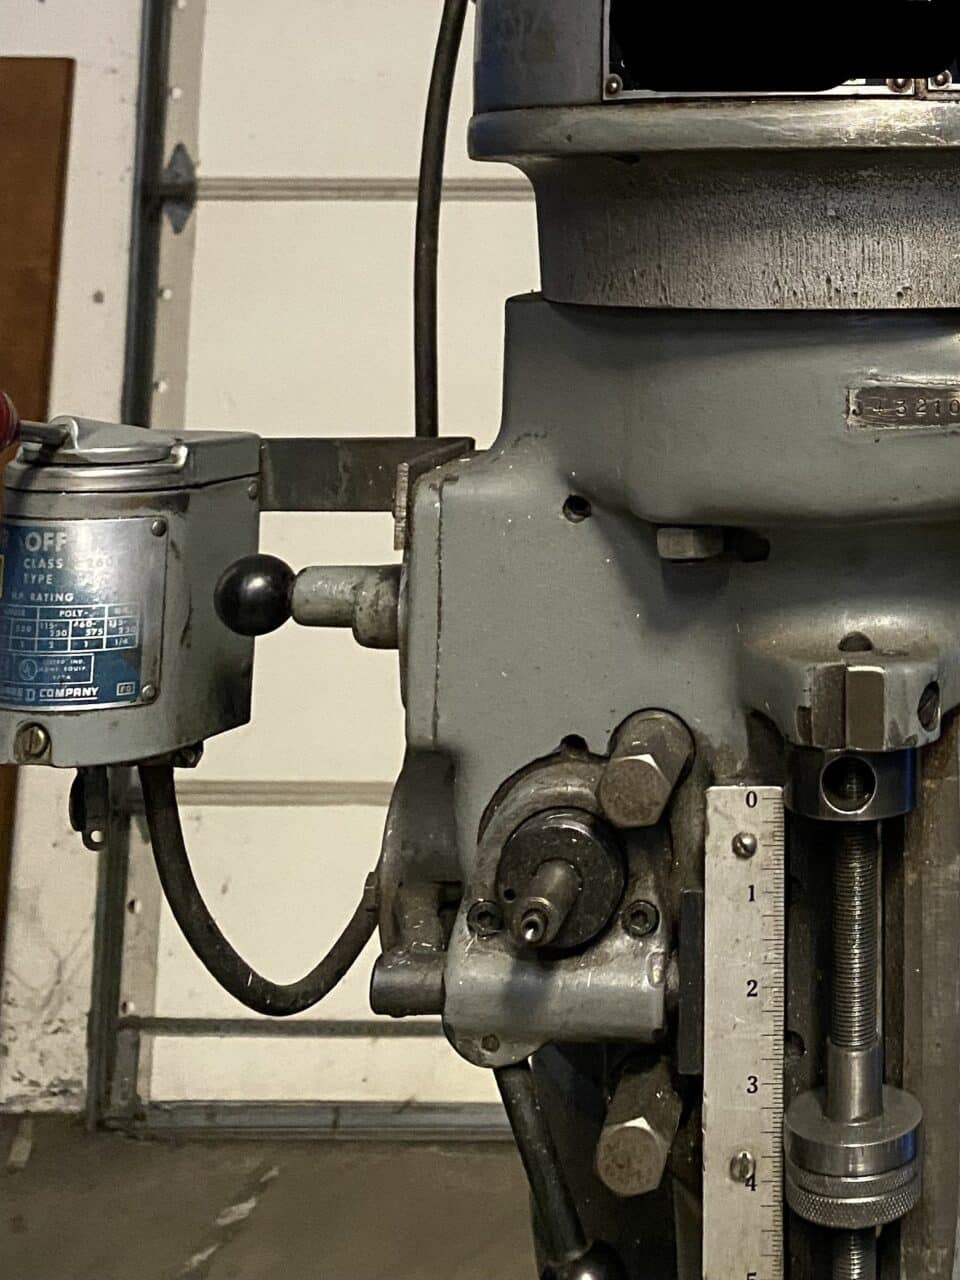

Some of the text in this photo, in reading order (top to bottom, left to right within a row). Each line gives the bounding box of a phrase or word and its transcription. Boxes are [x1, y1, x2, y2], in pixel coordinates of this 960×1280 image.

[24, 531, 68, 552] OFF
[23, 558, 64, 569] CLASS
[23, 574, 53, 585] TYPE
[30, 593, 74, 602] RATING
[39, 687, 99, 698] COMPANY
[746, 790, 758, 808] 0
[748, 885, 755, 902] 1
[746, 979, 758, 997] 2
[746, 1075, 758, 1094] 3
